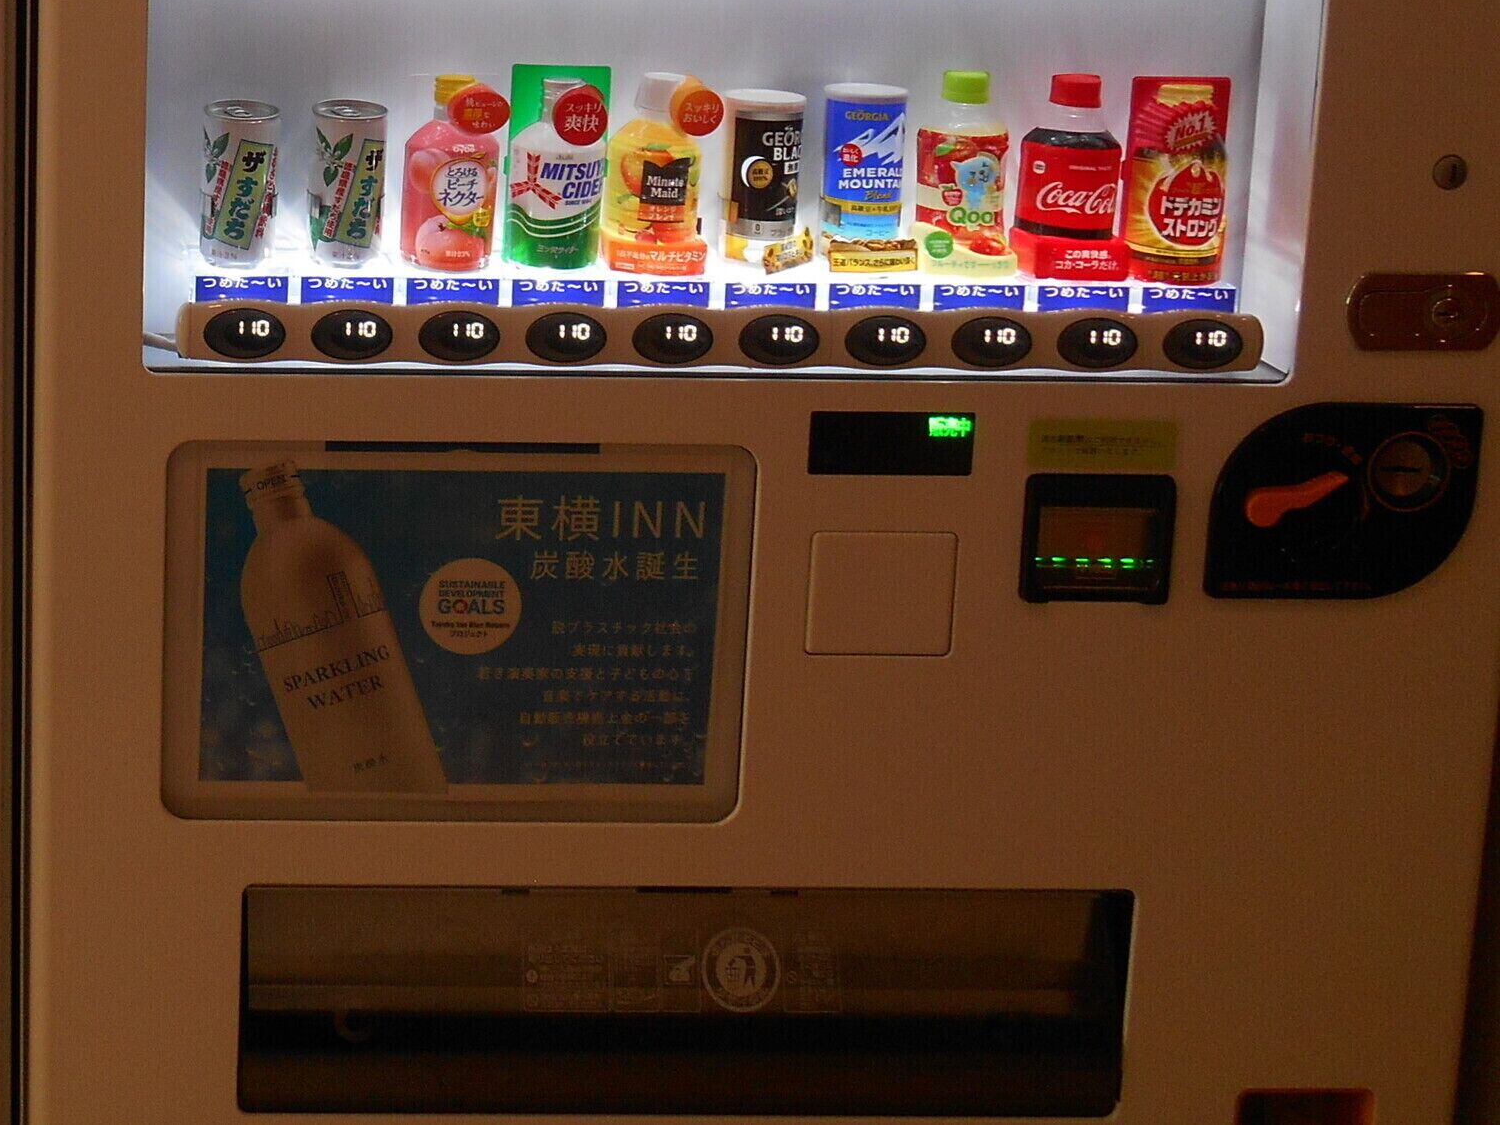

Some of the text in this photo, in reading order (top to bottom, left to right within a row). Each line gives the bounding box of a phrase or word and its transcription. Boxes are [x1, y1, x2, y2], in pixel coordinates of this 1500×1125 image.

[566, 103, 602, 113] スッキリ
[564, 116, 599, 132] 爽快
[683, 115, 716, 124] おいしく
[447, 167, 478, 177] とろける
[843, 167, 902, 178] EMERAL
[447, 179, 478, 191] ピーチ
[646, 176, 684, 188] Minute
[838, 178, 900, 189] MOUNTA
[437, 190, 484, 207] ネクター
[650, 187, 678, 198] Maid
[223, 176, 258, 240] すだち
[1160, 196, 1222, 216] ドデカミン
[950, 207, 992, 224] Qoo
[1161, 218, 1219, 238] ストロング
[649, 249, 705, 263] マルチビタミン
[345, 320, 377, 338] 110
[665, 324, 698, 342] 110
[877, 326, 910, 344] 110
[1195, 329, 1228, 347] 110
[256, 476, 287, 492] OPEN
[496, 495, 707, 542] 東横INN
[531, 551, 700, 580] 炭酸水誕生
[437, 599, 506, 615] GOALS
[283, 646, 391, 693] SPARKLING
[307, 675, 385, 712] WATER
